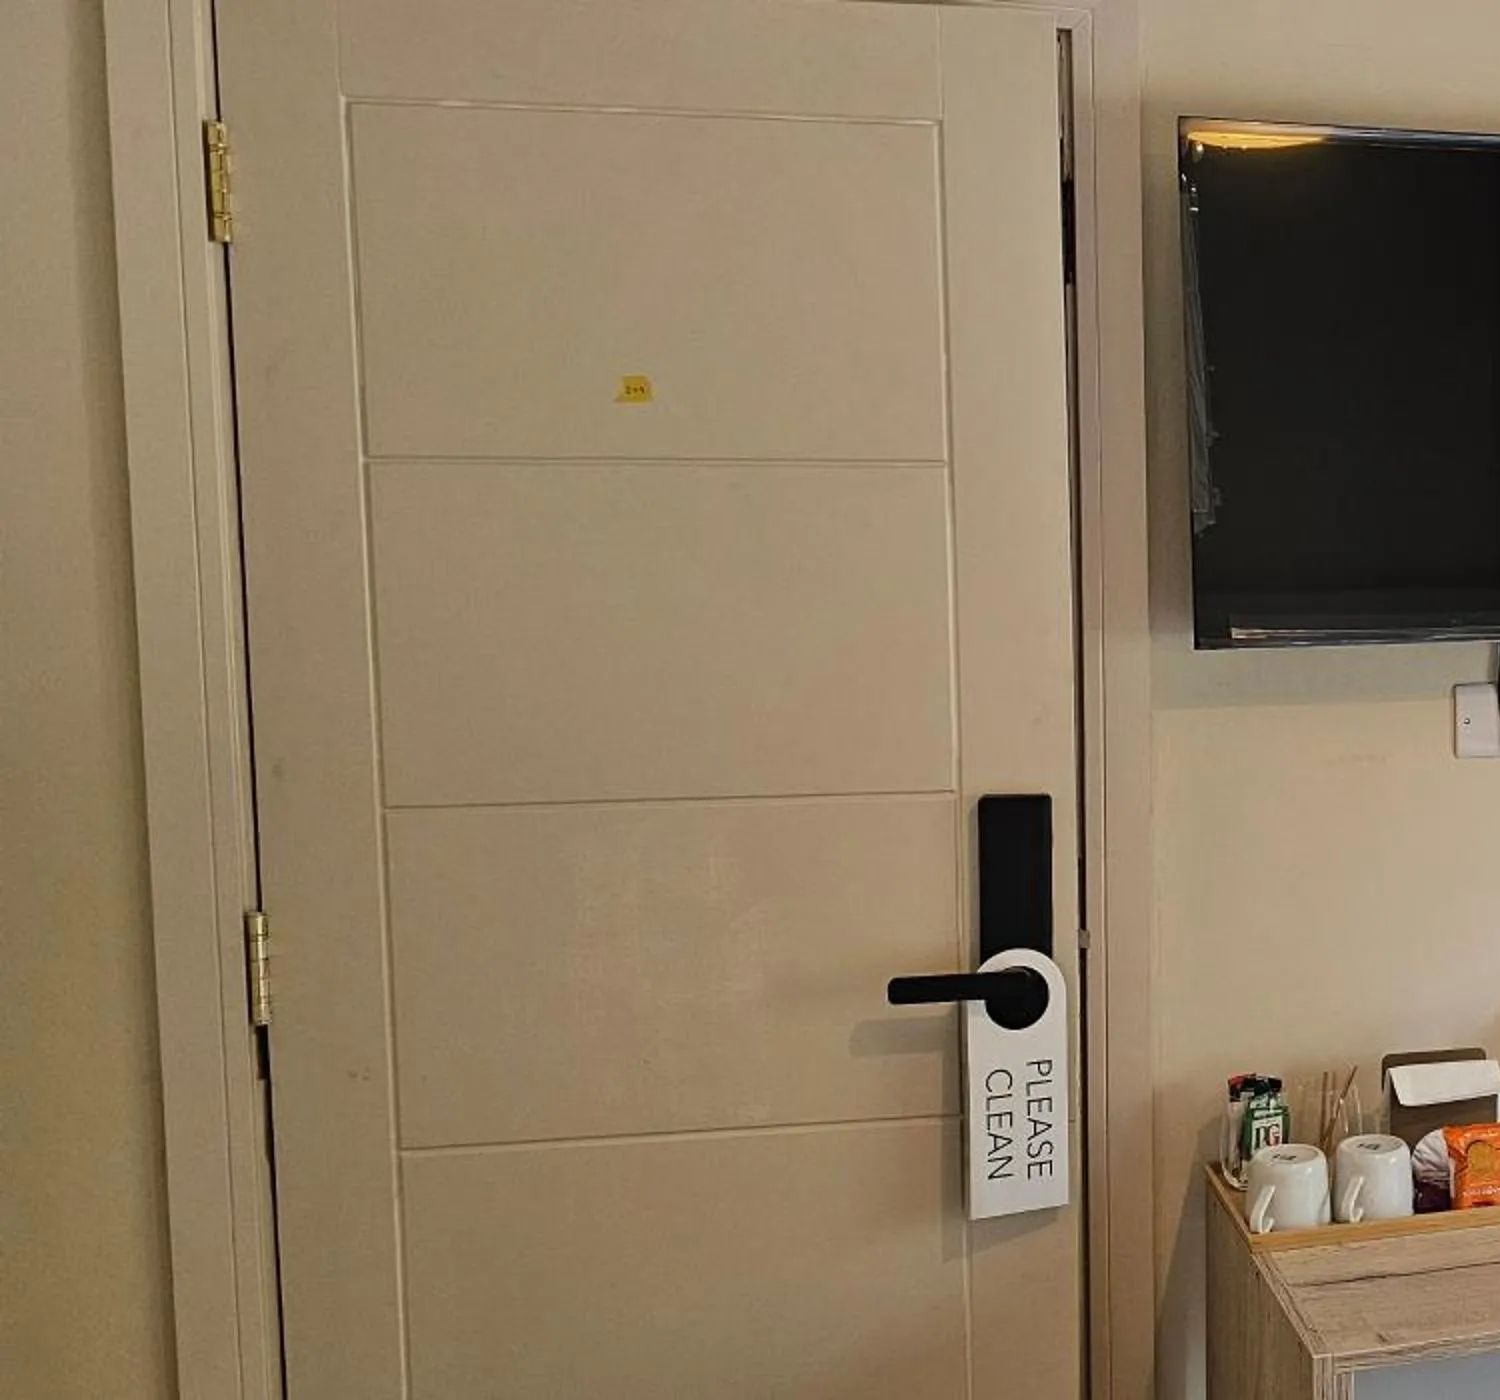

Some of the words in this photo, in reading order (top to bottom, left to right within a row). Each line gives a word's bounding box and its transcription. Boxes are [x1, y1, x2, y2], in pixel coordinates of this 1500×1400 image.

[985, 1069, 1014, 1180] CLEAN
[1026, 1059, 1053, 1180] PLEASE
[1255, 1123, 1280, 1149] PG
